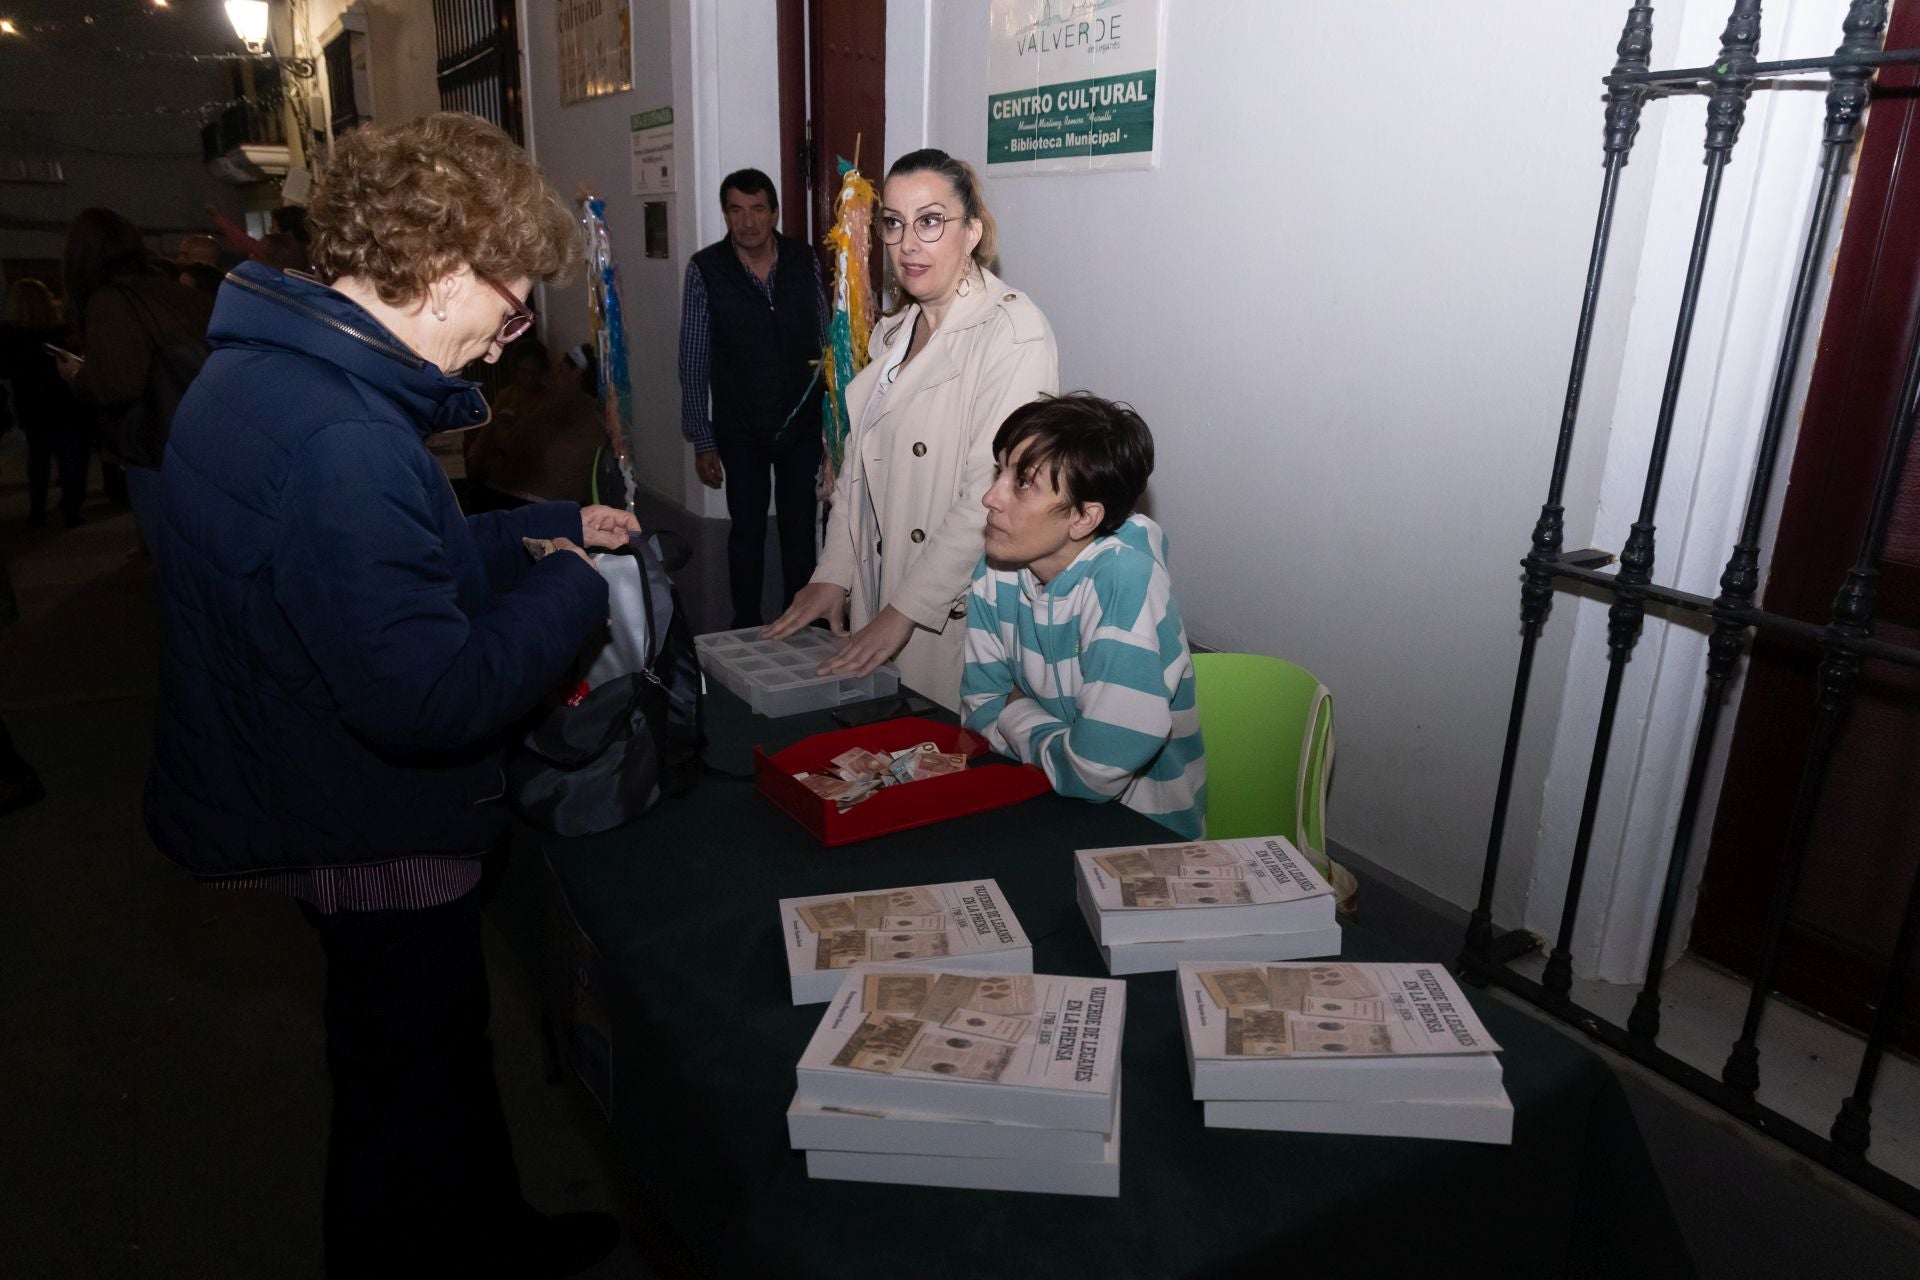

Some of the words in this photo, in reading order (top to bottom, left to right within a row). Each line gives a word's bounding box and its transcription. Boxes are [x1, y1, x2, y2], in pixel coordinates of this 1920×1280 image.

[1017, 14, 1122, 56] VALVERDE
[993, 93, 1052, 119] CENTRO
[1057, 80, 1147, 111] CULTURAL
[1011, 136, 1062, 152] Biblioteca
[1065, 128, 1120, 147] Municipal
[970, 912, 991, 935] PRENSA
[1403, 981, 1420, 991] EN
[1409, 992, 1427, 1002] LA
[1416, 969, 1449, 1002] VALVERDE
[1436, 1003, 1456, 1013] DE
[1063, 1013, 1081, 1024] LA
[1066, 1000, 1083, 1012] EN
[1085, 986, 1107, 1026] VALVERDE
[1415, 1003, 1445, 1033] PRENSA
[1055, 1026, 1078, 1061] PRENSA
[1083, 1027, 1100, 1040] DE
[1075, 1040, 1099, 1082] LEGANÉS
